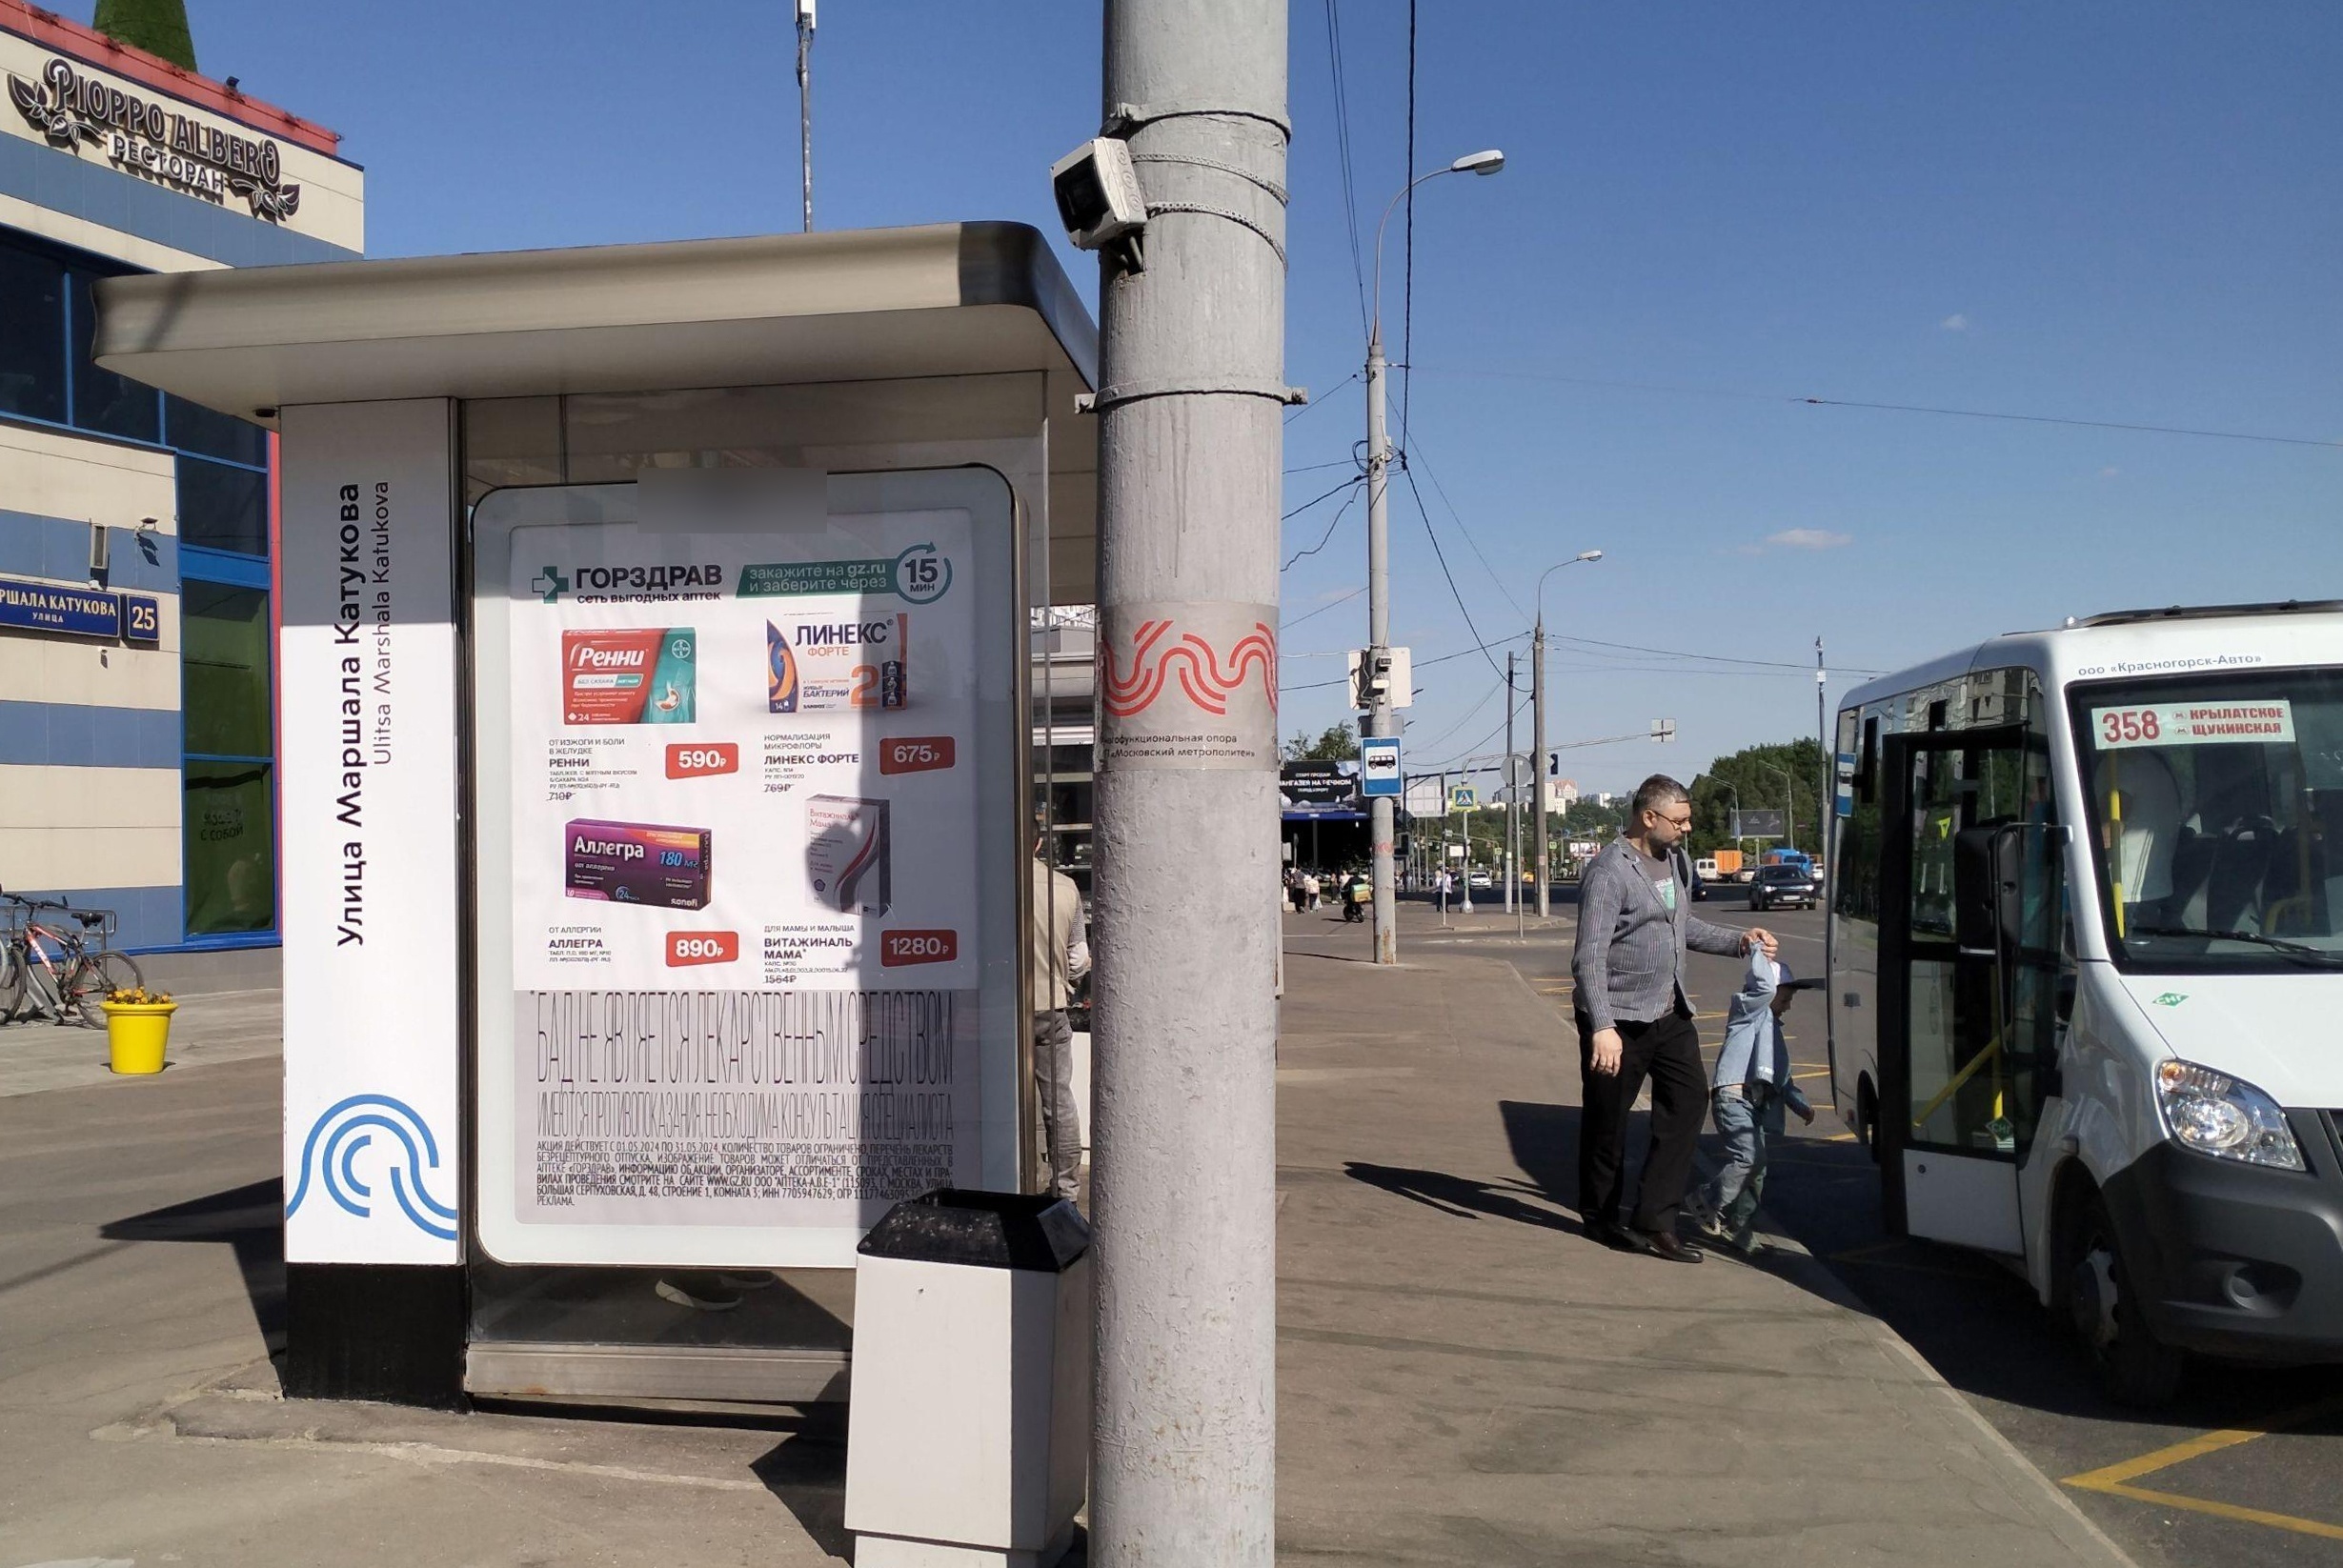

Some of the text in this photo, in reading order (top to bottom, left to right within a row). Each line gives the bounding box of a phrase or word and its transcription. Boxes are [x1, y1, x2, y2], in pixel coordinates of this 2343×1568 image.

[44, 57, 281, 186] PIOPPO ALBERO
[108, 133, 226, 195] РЕСТОРАН
[576, 565, 722, 592] ГОРЗДРАВ
[749, 563, 886, 579] закажите на gz.ru
[905, 558, 937, 584] 15
[749, 578, 887, 593] и заберите через
[49, 595, 116, 616] КАТУКОВА
[577, 591, 721, 605] сеть выгодных аптек
[131, 606, 155, 631] 25
[372, 481, 392, 765] Ulitsa Marshala Katukova
[796, 622, 887, 646] ЛИНЕКС
[578, 647, 645, 667] Ренни
[808, 647, 849, 656] ФОРТЕ
[2111, 654, 2262, 674] «Красногорск-Авто»
[850, 664, 879, 705] 2
[803, 688, 849, 698] БАКТЕРИЙ
[334, 483, 368, 947] Улица Маршала Катукова
[2190, 708, 2284, 720] КРЫЛАТСКОЕ
[2102, 710, 2161, 743] 358
[2192, 723, 2282, 735] ЩУКИНСКАЯ
[1207, 735, 1237, 745] опора
[549, 758, 590, 768] РЕННИ
[764, 754, 858, 765] ЛИНЕКС ФОРТЕ
[575, 835, 644, 861] Аллегра
[659, 851, 682, 866] 180
[671, 897, 698, 908] sanofi
[549, 938, 603, 948] АЛЛЕГРА
[764, 937, 853, 947] ВИТАЖИНАЛЬ
[579, 992, 598, 1083] НЕ
[604, 992, 689, 1083] ЯВЛЯЕТСЯ
[695, 992, 842, 1084] ЛЕКАРСТВЕННЫМ
[847, 992, 953, 1094] СРЕДСТВОМ
[537, 1092, 588, 1137] ИМЕЮТСЯ
[706, 1093, 778, 1144] НЕОБХОДИМА
[782, 1093, 869, 1143] КОНСУЛЬТАЦИЯ
[537, 1141, 565, 1153] АКЦИЯ
[565, 1140, 607, 1153] ДЕЙСТВУЕТ
[616, 1142, 659, 1153] 01.05.2024
[662, 1142, 673, 1153] ПО
[722, 1143, 774, 1154] КОЛИЧЕСТВО
[777, 1143, 812, 1154] ТОВАРОВ
[871, 1145, 911, 1156] ПЕРЕЧЕНЬ
[912, 1145, 953, 1156] ЛЕКАРСТВ
[537, 1152, 609, 1163] БЕЗРЕЦЕПТУРНОГО
[657, 1153, 714, 1164] ИЗОБРАЖЕНИЕ
[720, 1154, 756, 1164] ТОВАРОВ
[761, 1154, 790, 1164] МОЖЕТ
[796, 1154, 846, 1165] ОТЛИЧАТЬСЯ
[537, 1163, 565, 1174] АПТЕКЕ
[619, 1164, 678, 1175] ИНФОРМАЦИЮ
[892, 1167, 923, 1177] МЕСТАХ
[537, 1174, 562, 1184] ВИЛАХ
[565, 1174, 616, 1185] ПРОВЕДЕНИЯ
[619, 1175, 660, 1185] СМОТРИТЕ
[663, 1175, 674, 1185] НА
[679, 1175, 703, 1186] САЙТЕ
[537, 1185, 574, 1196] БОЛЬШАЯ
[576, 1185, 637, 1197] СЕРПУХОВСКАЯ,
[662, 1186, 702, 1197] СТРОЕНИЕ
[714, 1187, 751, 1197] КОМНАТА
[762, 1188, 779, 1198] ИНН
[537, 1196, 575, 1206] РЕКЛАМА.
